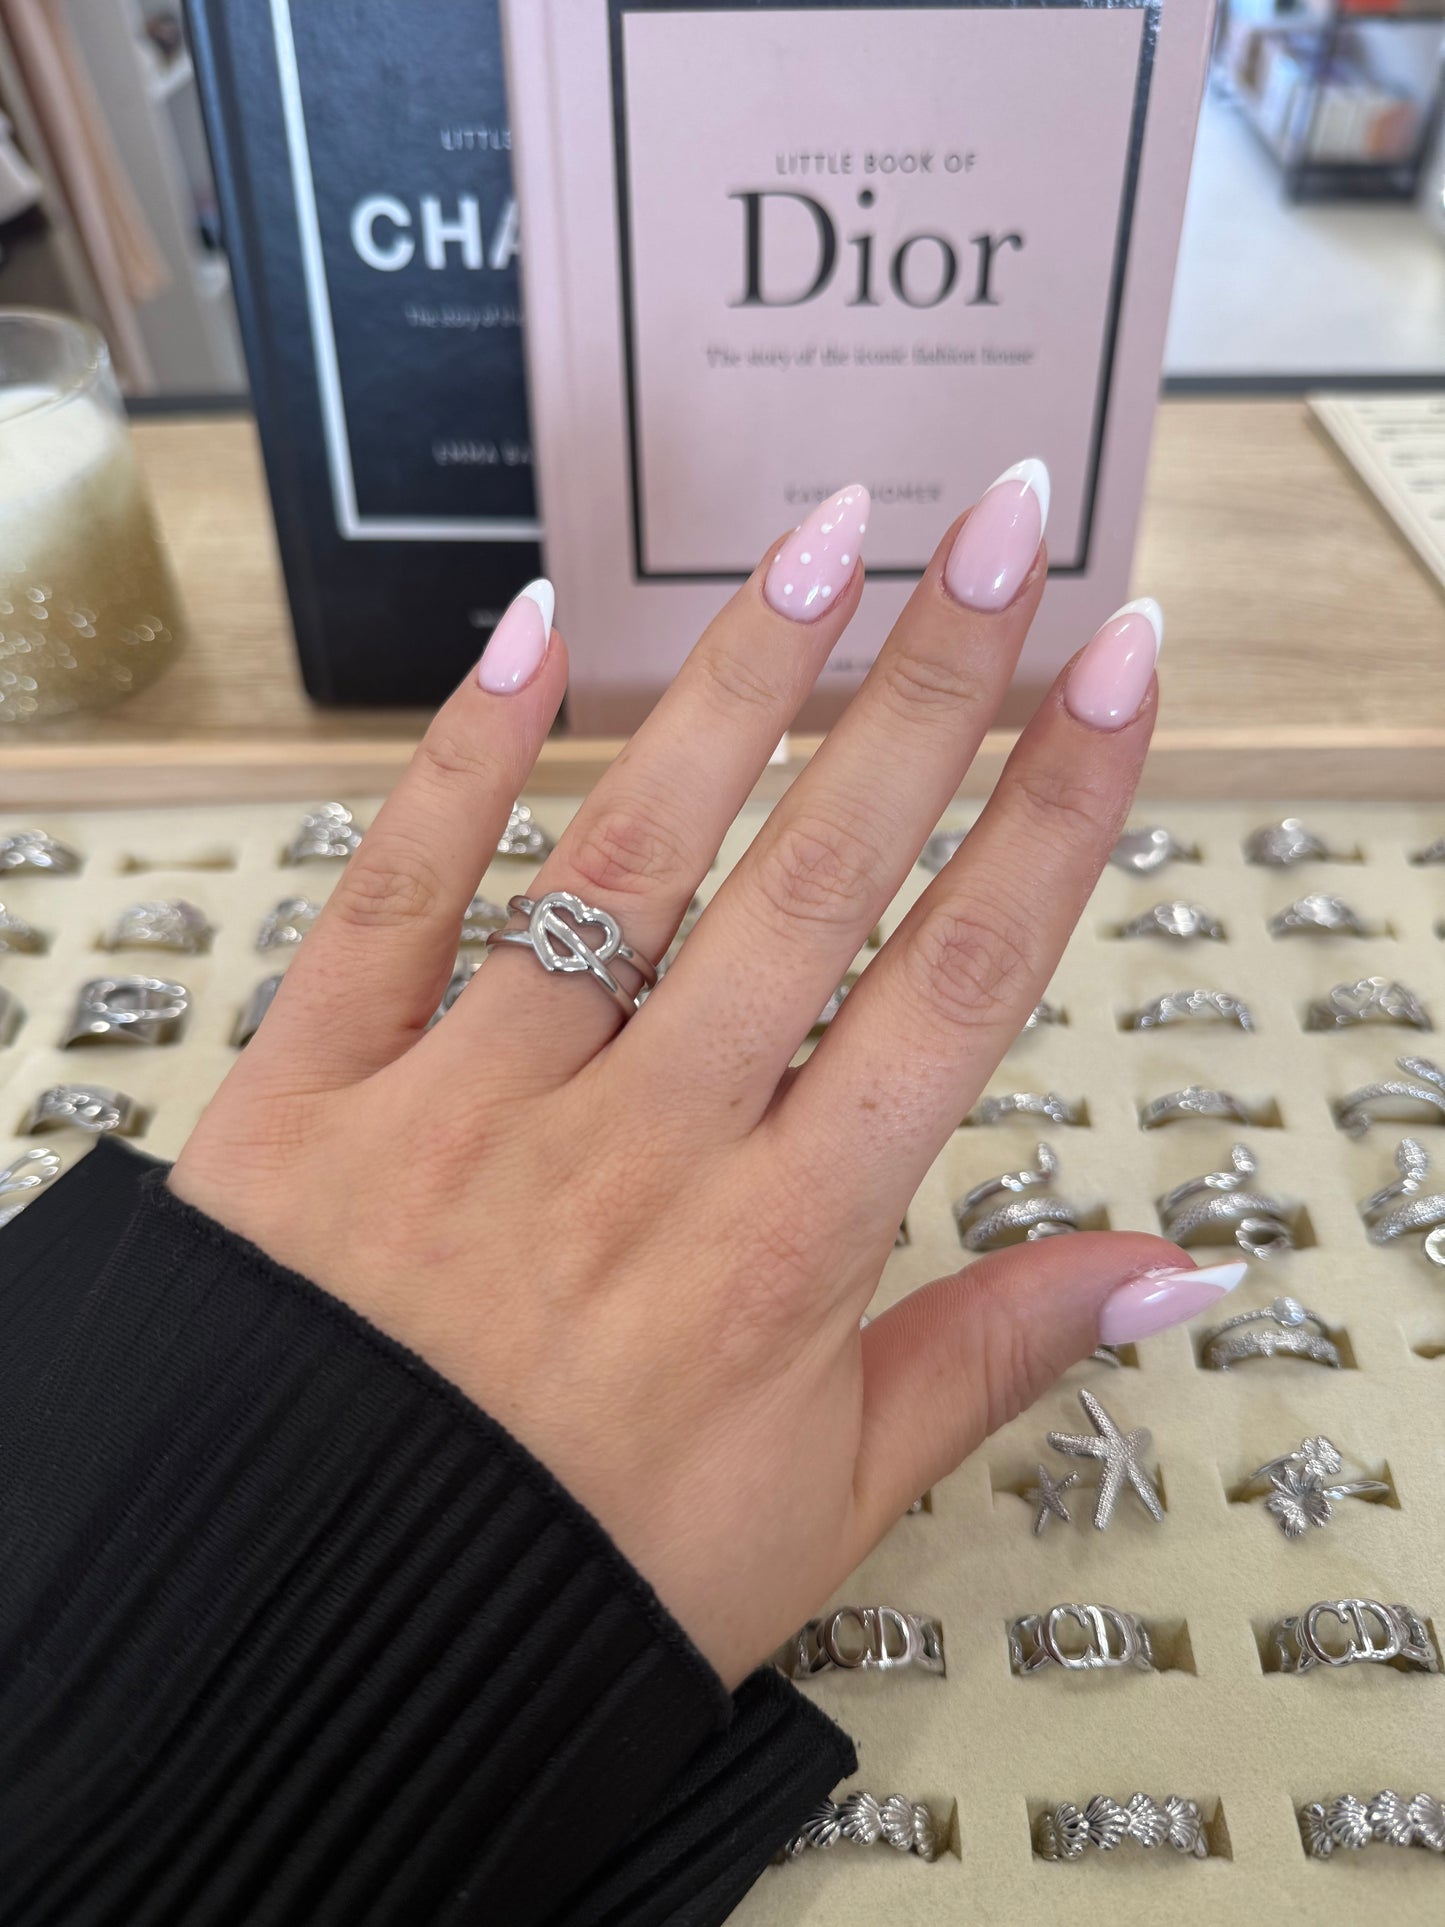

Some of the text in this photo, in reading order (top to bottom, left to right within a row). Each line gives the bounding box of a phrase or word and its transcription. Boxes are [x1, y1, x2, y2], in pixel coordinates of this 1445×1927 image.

[775, 151, 980, 175] LITTLE BOOK OF
[726, 187, 1024, 309] Dior
[706, 340, 1035, 373] The story of the iconic fashion house
[1302, 1598, 1400, 1668] CD
